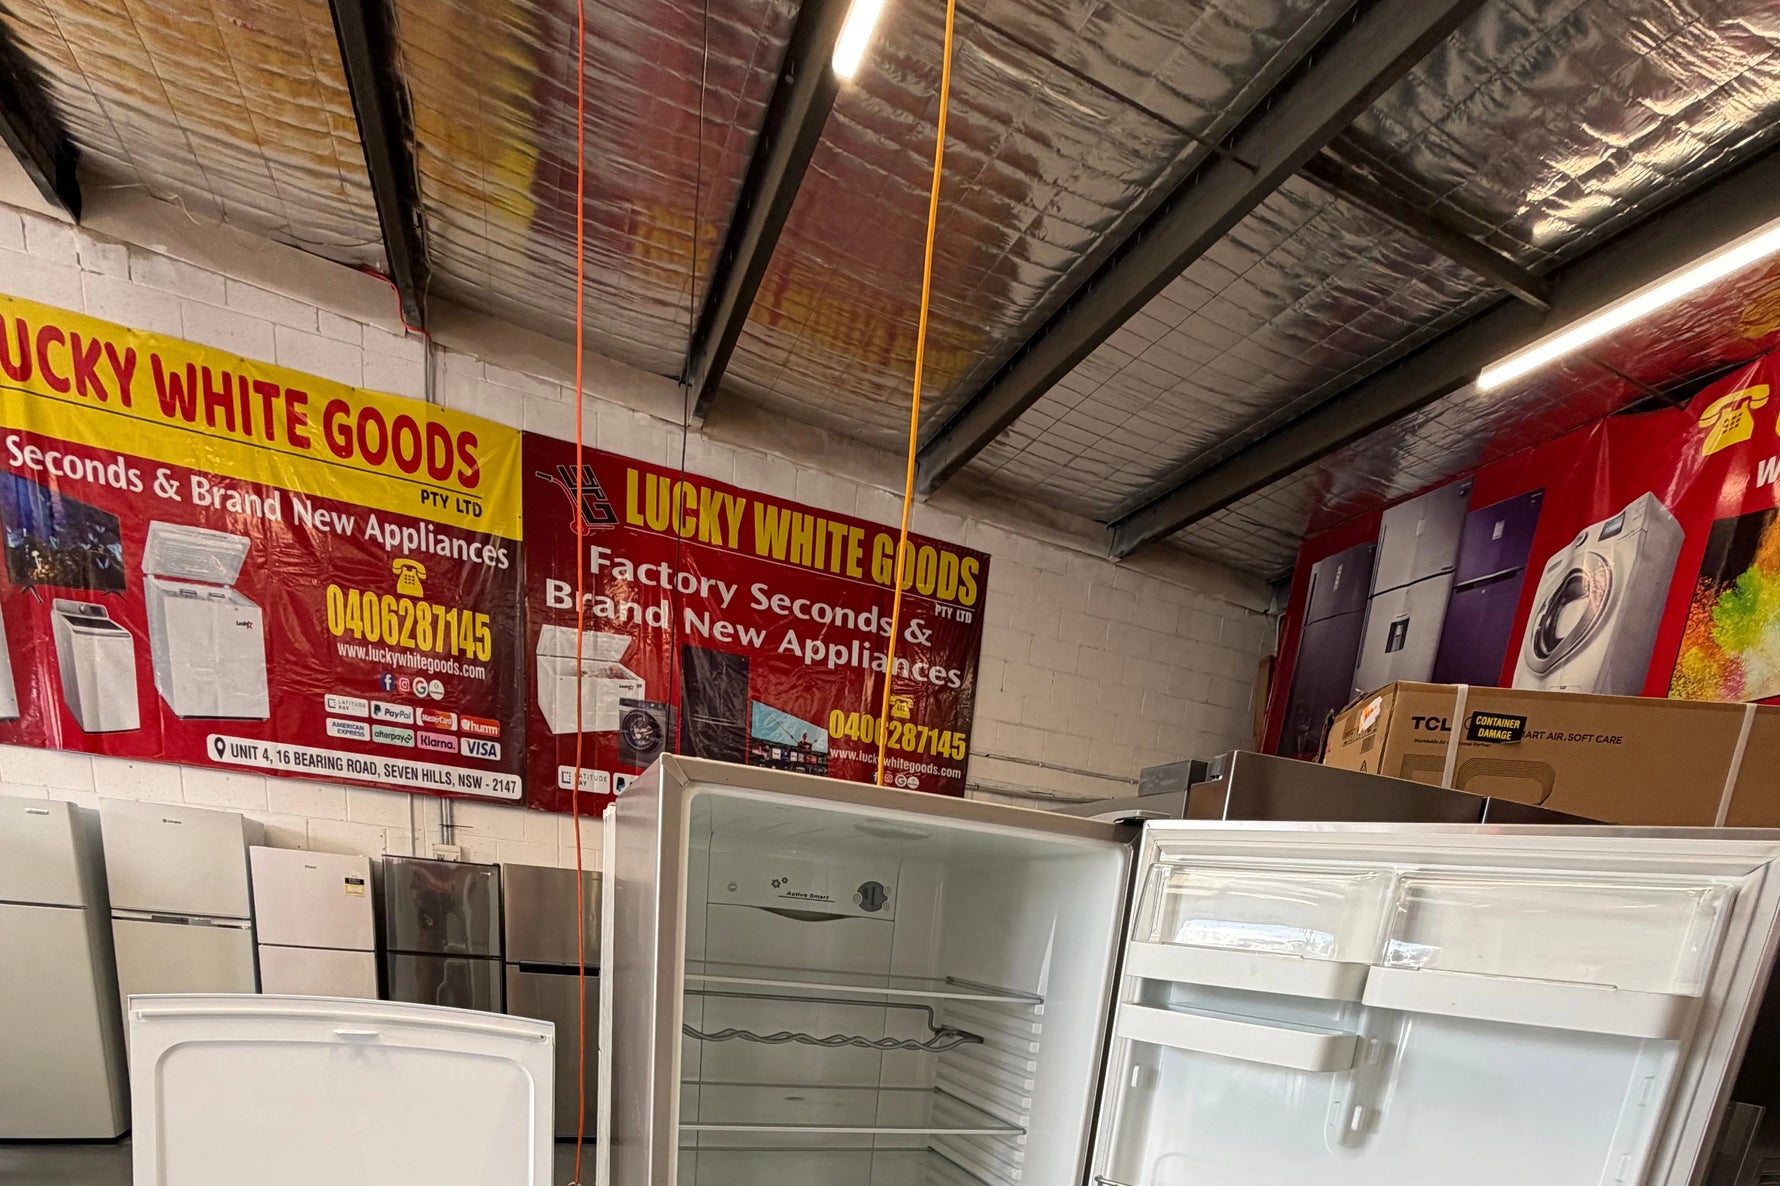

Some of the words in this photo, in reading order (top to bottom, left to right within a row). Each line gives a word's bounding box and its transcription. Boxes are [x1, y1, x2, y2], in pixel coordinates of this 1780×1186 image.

[0, 314, 137, 407] UCKY
[151, 353, 313, 450] WHITE
[323, 399, 481, 489] GOODS
[6, 435, 144, 494] Seconds
[153, 468, 181, 500] &
[192, 474, 281, 522] Brand
[293, 499, 355, 537] New
[364, 515, 509, 569] Appliances
[421, 489, 449, 509] PTY
[456, 498, 482, 517] LTD
[626, 468, 747, 550] LUCKY
[754, 501, 864, 579] WHITE
[871, 533, 979, 606] GOODS
[590, 545, 737, 609] Factory
[750, 583, 893, 638] Seconds
[904, 619, 932, 647] &
[934, 604, 953, 619] PTY
[956, 609, 972, 624] LTD
[327, 584, 493, 662] 0406287145
[545, 578, 669, 629] Brand
[685, 608, 767, 649] New
[778, 629, 962, 688] Appliances
[337, 642, 486, 680] www.luckywhitegoods.com
[338, 700, 366, 708] LATITUDE
[384, 708, 411, 719] PayPal
[422, 714, 452, 725] MasterCard
[332, 721, 364, 731] AMERICAN
[470, 720, 498, 735] humm
[1411, 716, 1453, 732] TCL
[1475, 715, 1521, 729] CONTAINER
[337, 729, 365, 738] EXPRESS
[374, 730, 405, 742] afterpay
[1477, 728, 1513, 740] DAMAGE
[1567, 733, 1595, 743] SOFT
[1595, 735, 1623, 745] CARE
[466, 740, 497, 757] VISA
[231, 743, 258, 760] UNIT
[262, 748, 273, 765] 4,
[276, 750, 290, 764] 16
[294, 752, 343, 771] BEARING
[347, 759, 381, 778] ROAD,
[384, 763, 418, 781] SEVEN
[422, 769, 455, 787] HILLS,
[458, 774, 482, 790] NSW
[492, 779, 517, 794] 2147
[830, 748, 962, 780] www.luckwhitegoods.com
[579, 773, 607, 783] ATITUDE
